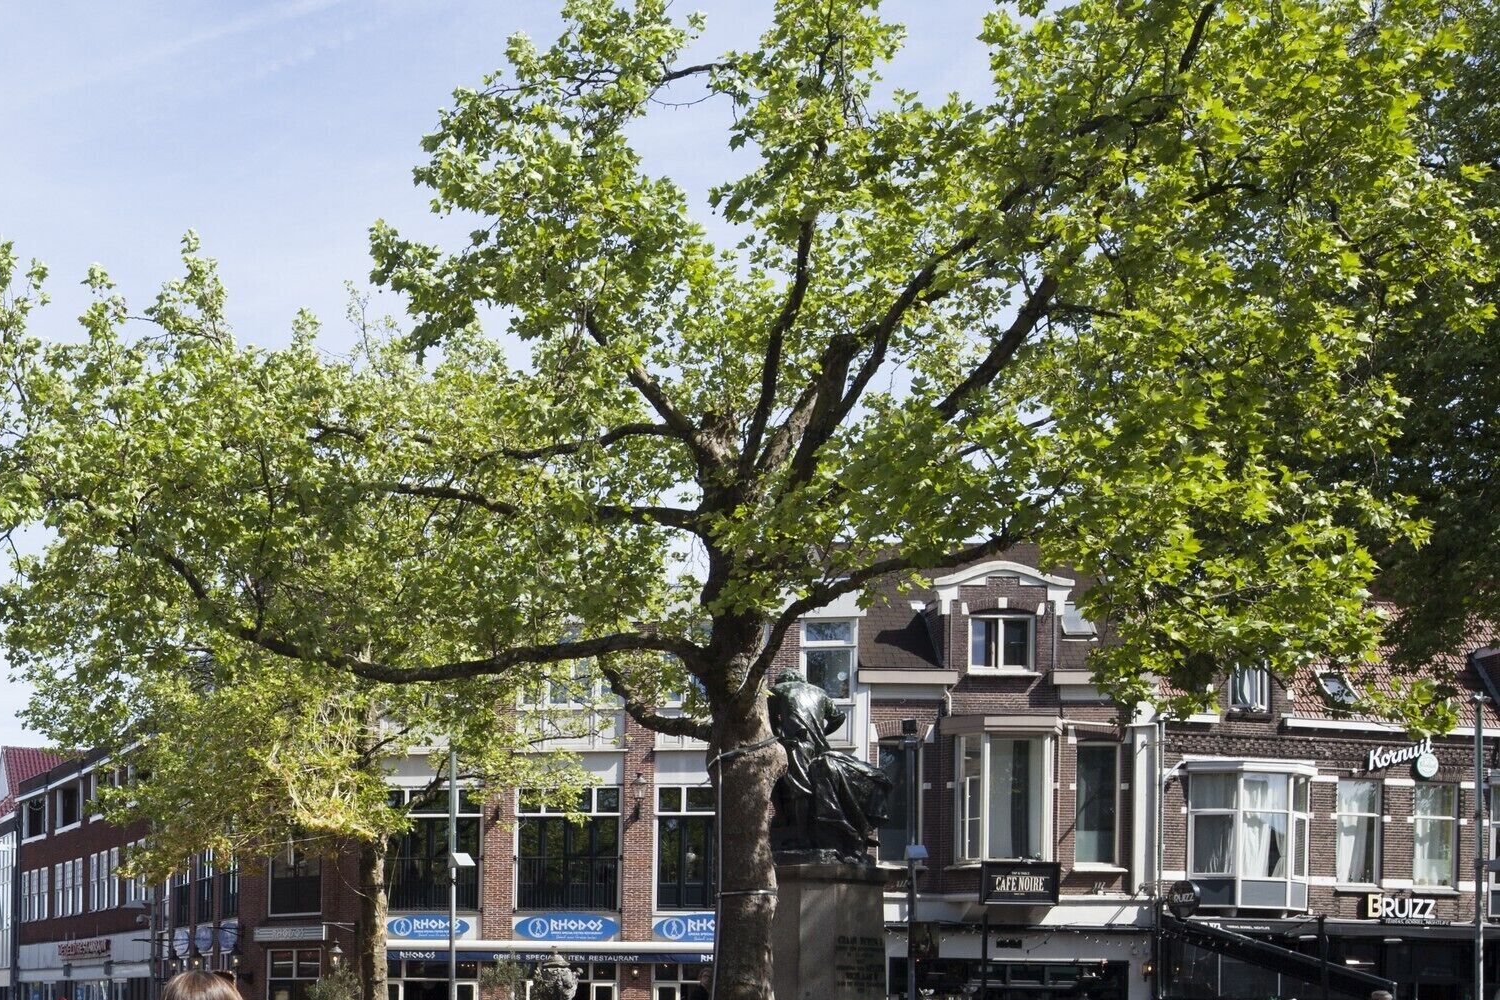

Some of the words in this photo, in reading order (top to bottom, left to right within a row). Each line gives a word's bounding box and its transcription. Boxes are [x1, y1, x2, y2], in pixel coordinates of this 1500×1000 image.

[1368, 736, 1435, 771] Kornuit
[995, 876, 1017, 891] CAFE
[1019, 876, 1045, 891] NOIRE
[1367, 893, 1436, 919] BRUIZZ
[550, 918, 604, 931] RHODOS
[400, 951, 436, 959] RHODOS
